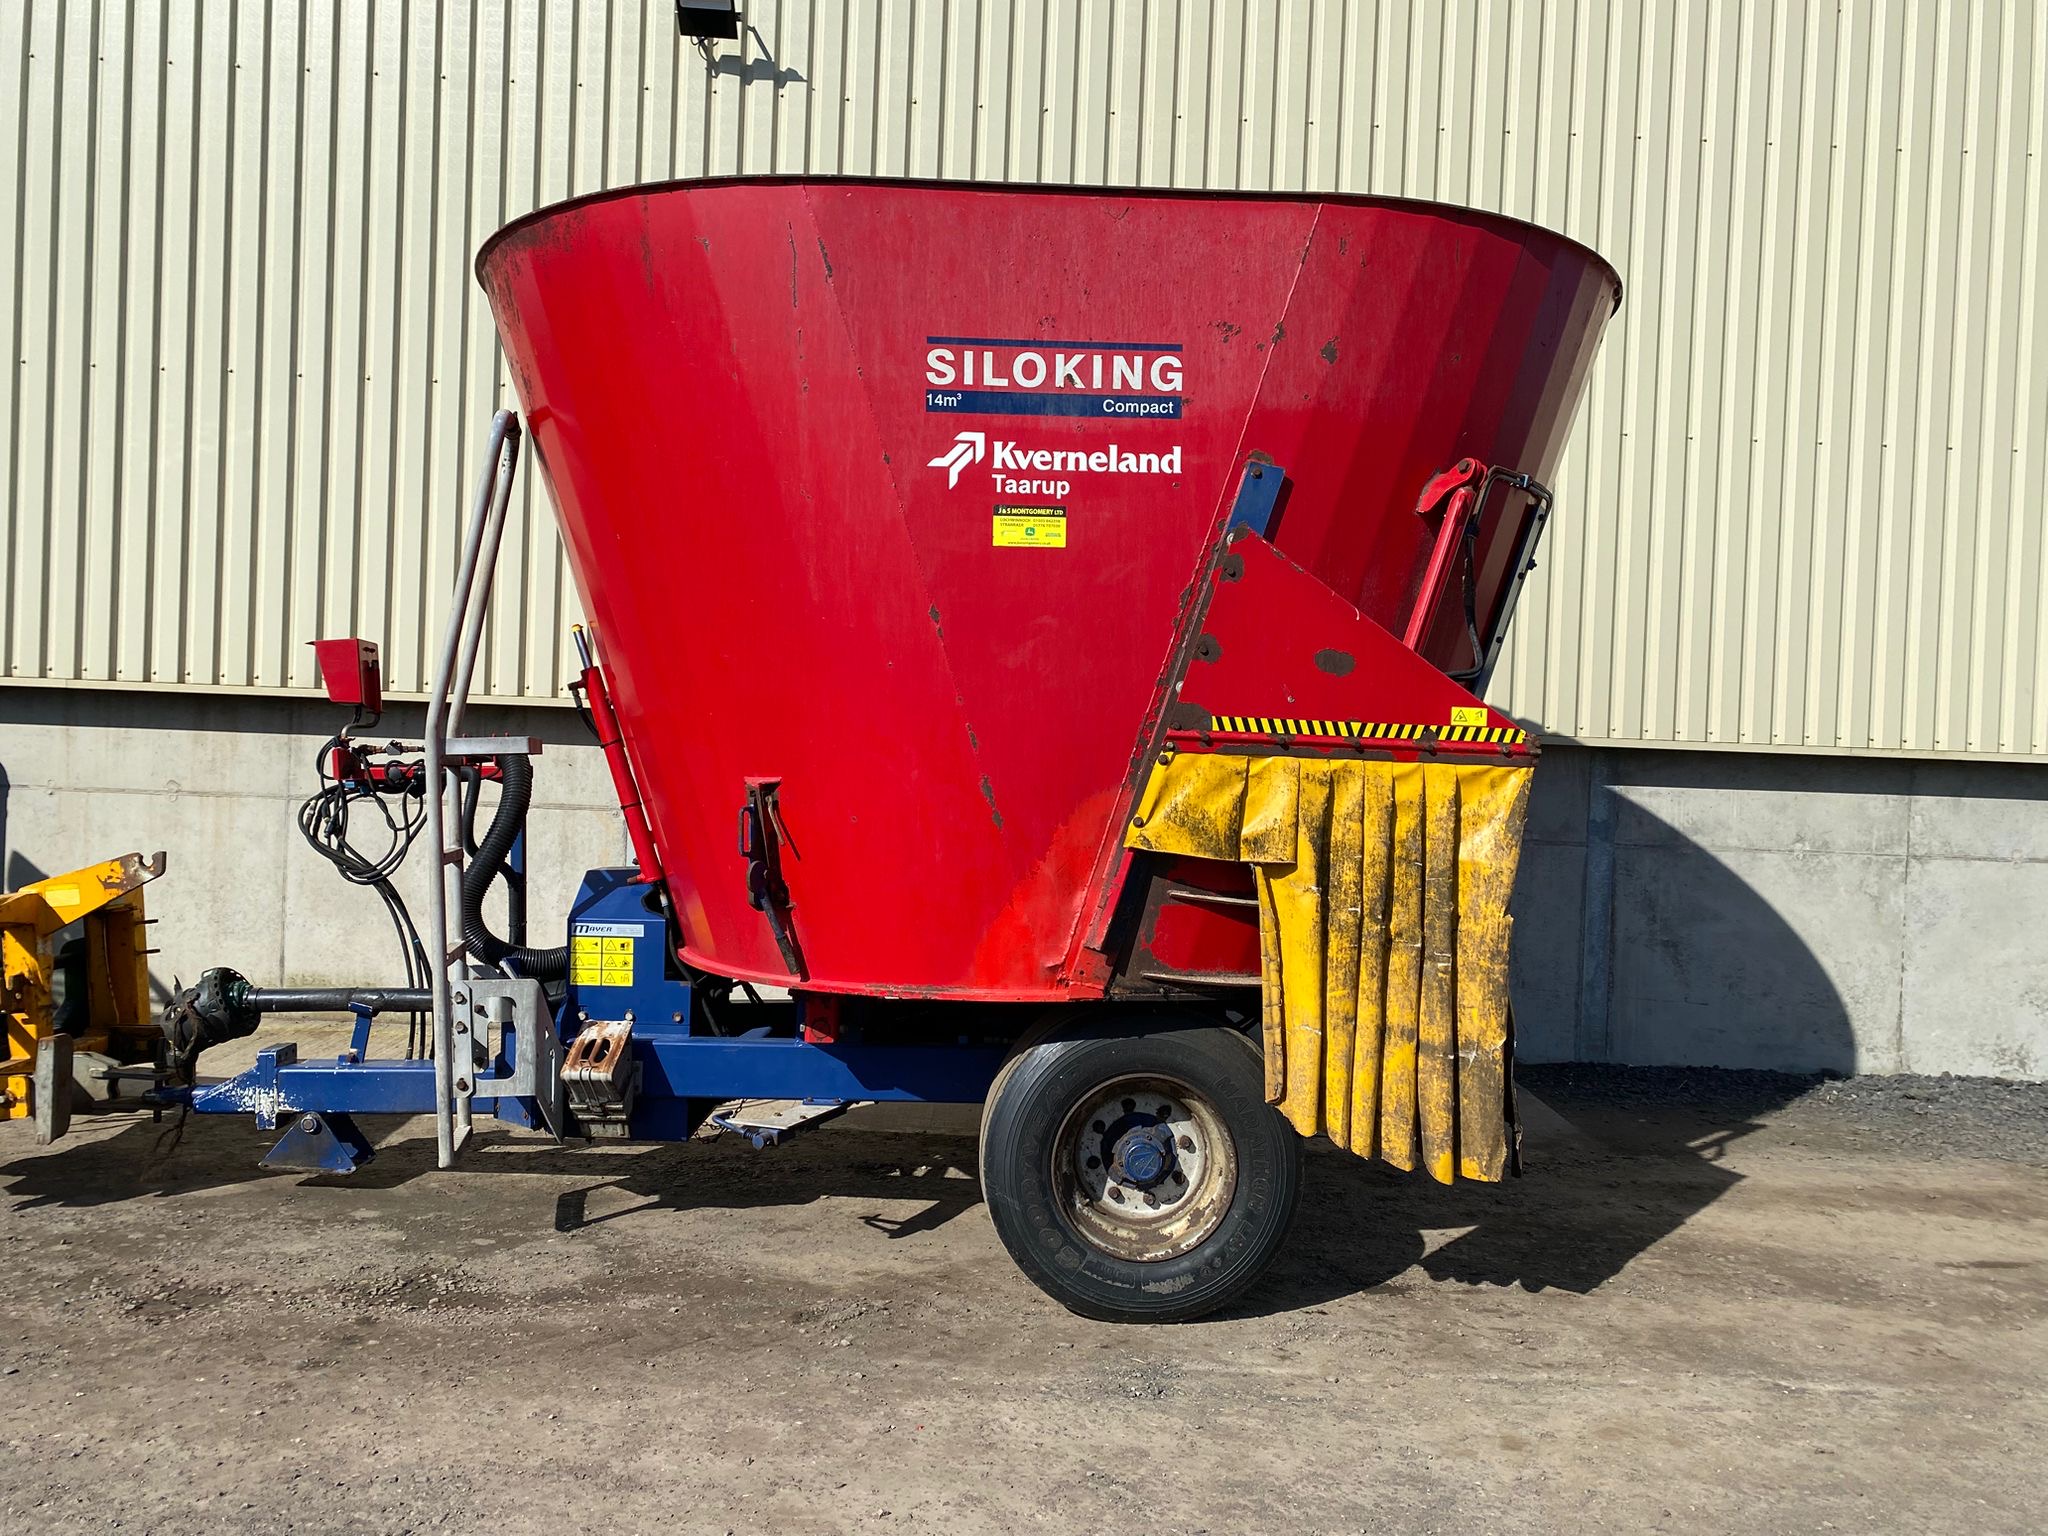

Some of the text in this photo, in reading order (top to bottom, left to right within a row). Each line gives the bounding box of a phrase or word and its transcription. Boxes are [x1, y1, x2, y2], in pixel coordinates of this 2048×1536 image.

[925, 348, 1183, 392] SILOKING
[1103, 399, 1174, 416] Compact
[992, 441, 1182, 474] Kverneland
[992, 474, 1071, 499] Taarup
